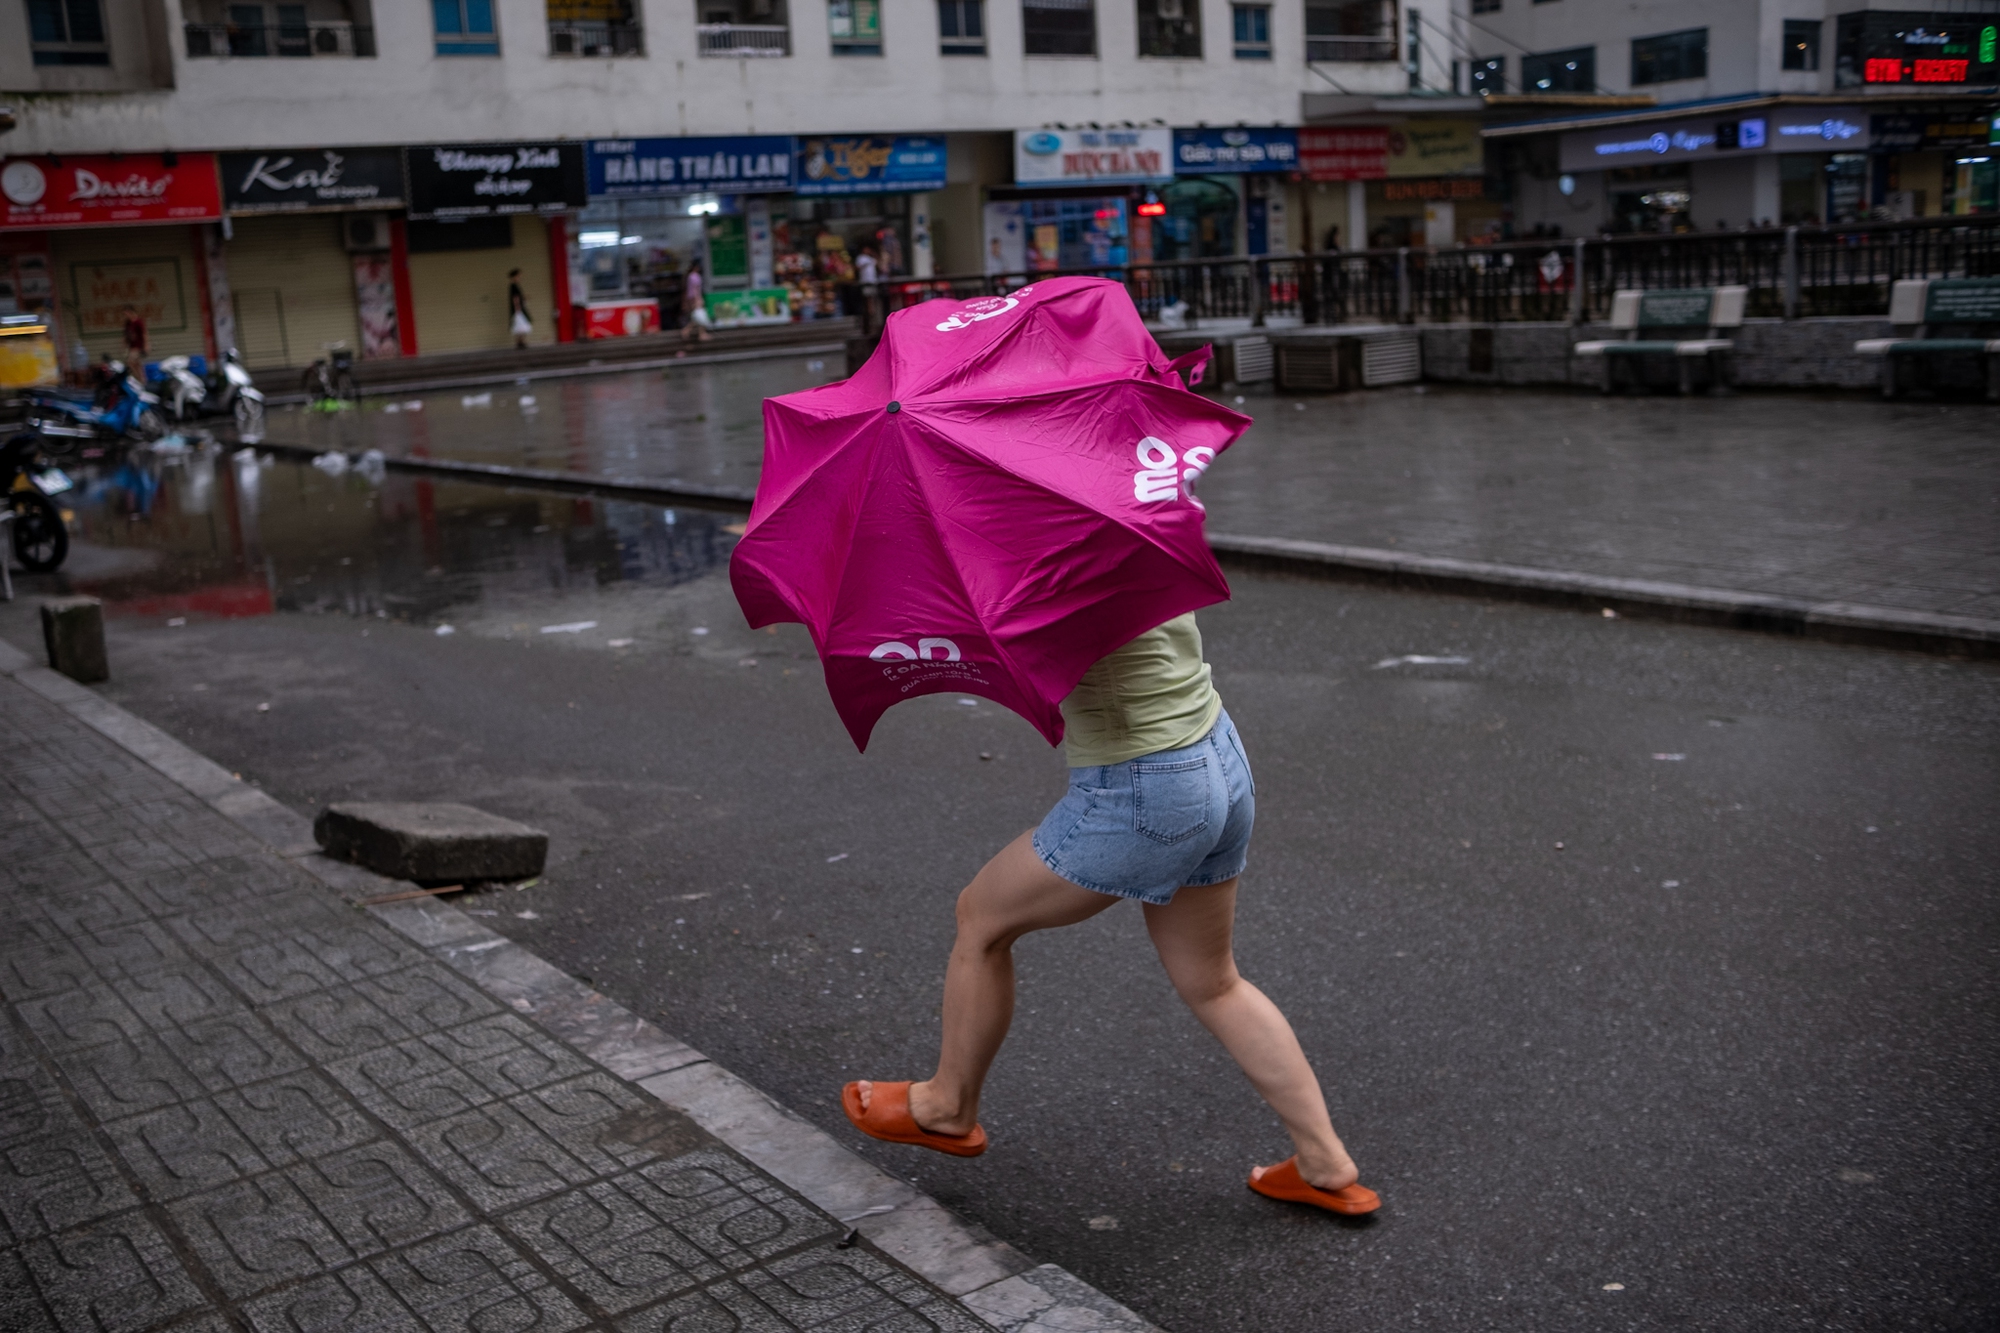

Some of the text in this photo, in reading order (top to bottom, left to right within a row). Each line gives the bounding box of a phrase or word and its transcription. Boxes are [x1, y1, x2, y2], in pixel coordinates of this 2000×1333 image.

[604, 150, 791, 183] HÀNG THÁI LAN
[901, 679, 921, 692] QUA
